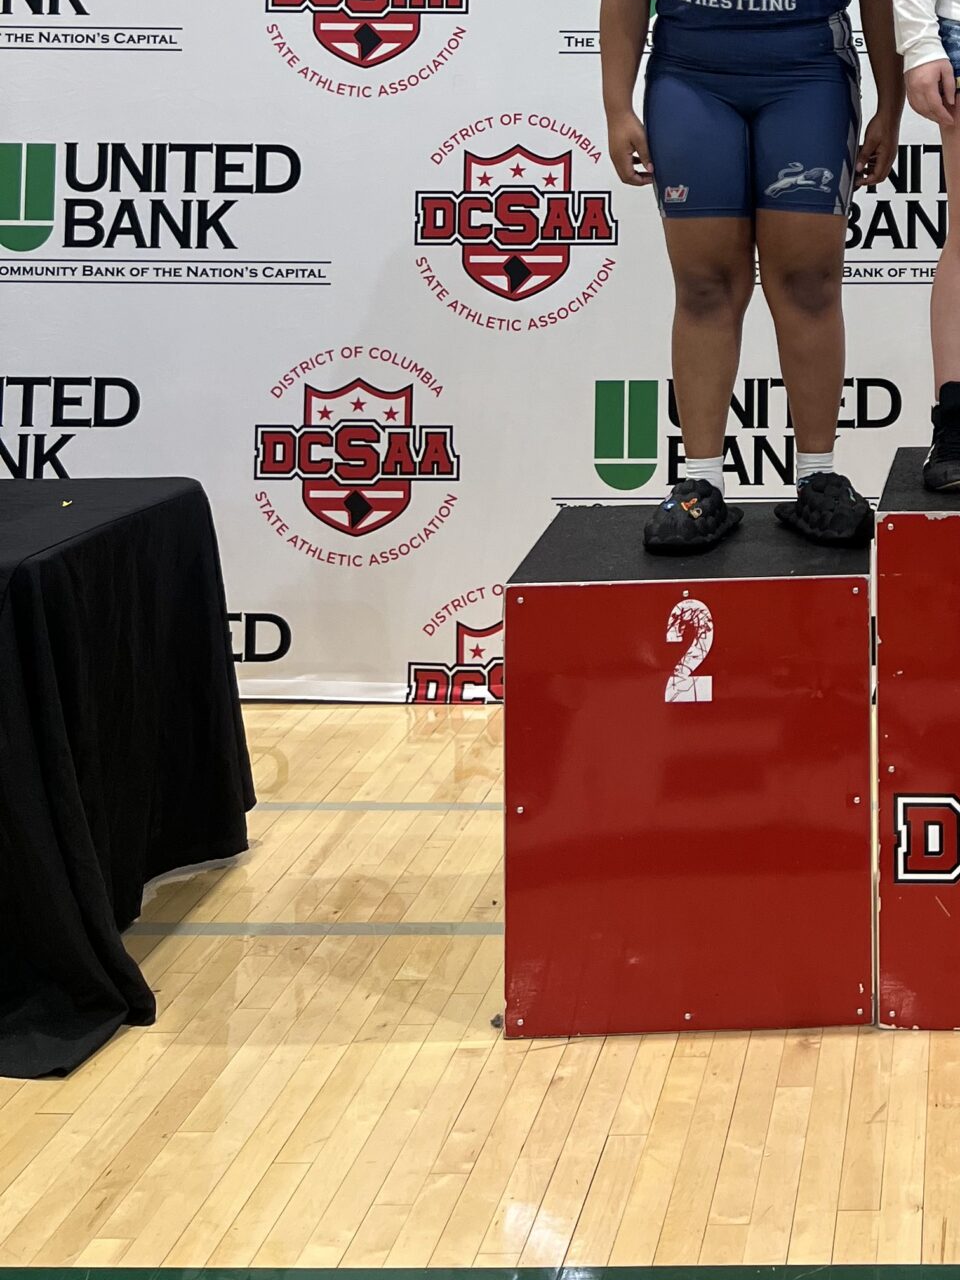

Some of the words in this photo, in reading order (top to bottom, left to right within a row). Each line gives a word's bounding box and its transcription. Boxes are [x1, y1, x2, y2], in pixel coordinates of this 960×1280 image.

[266, 23, 299, 68] STATE
[299, 66, 370, 98] ATHLETIC
[378, 26, 466, 97] ASSOCIATION
[65, 143, 301, 194] UNITED
[431, 116, 494, 166] DISTRICT
[498, 111, 524, 127] OF
[526, 113, 602, 162] COLUMBIA
[62, 199, 238, 249] BANK
[415, 185, 618, 251] DCSAA
[0, 266, 78, 276] OMMUNITY
[82, 265, 125, 276] BANK
[130, 267, 149, 277] OF
[153, 268, 182, 277] THE
[262, 267, 326, 278] CAPITAL
[415, 256, 449, 302] STATE
[447, 299, 520, 333] ATHLETIC
[527, 258, 616, 330] ASSOCIATION
[271, 349, 334, 399] DISTRICT
[339, 345, 363, 361] OF
[367, 347, 444, 397] COLUMBIA
[254, 419, 460, 486] DCSAA
[254, 490, 290, 537] STATE
[287, 534, 364, 570] ATHLETIC
[367, 494, 459, 566] ASSOCIATION
[665, 599, 714, 702] 2
